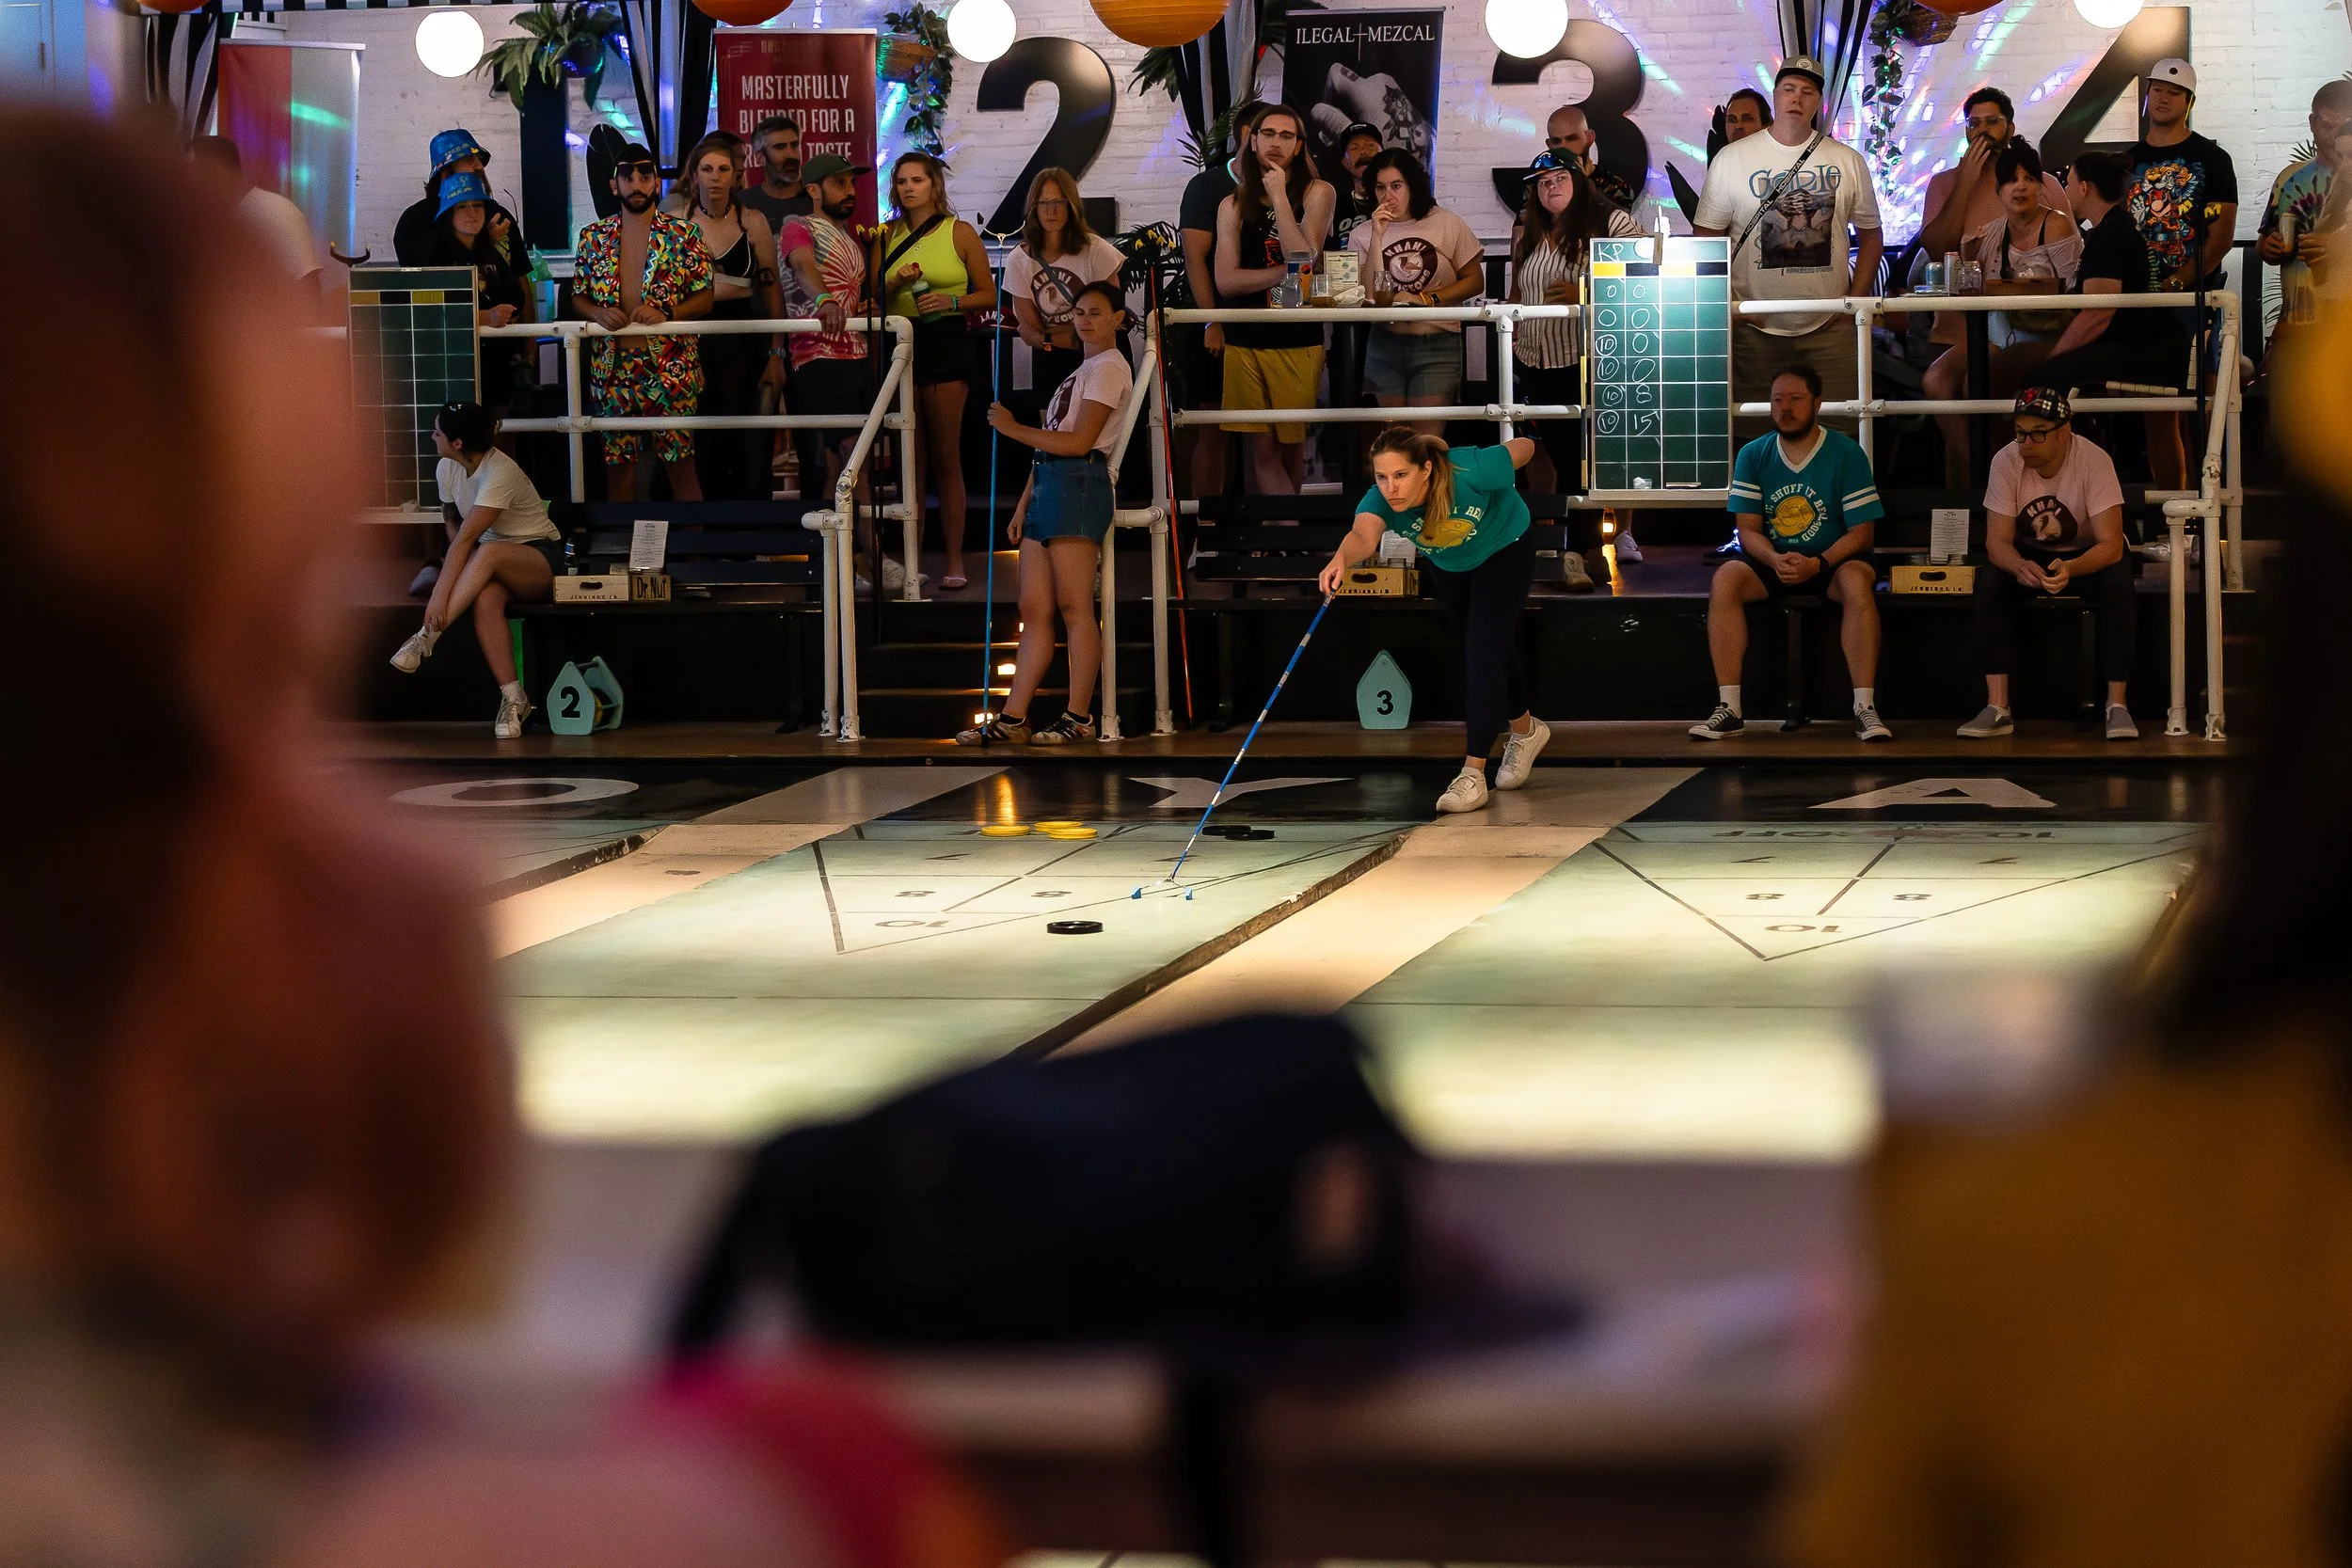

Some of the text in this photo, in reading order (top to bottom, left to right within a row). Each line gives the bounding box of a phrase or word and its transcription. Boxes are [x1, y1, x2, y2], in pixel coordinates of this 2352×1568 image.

[1296, 24, 1436, 44] ILEGAL MEZCAL
[741, 74, 850, 100] MASTERFULLY
[2040, 7, 2217, 179] 4
[812, 108, 840, 133] FOR
[845, 108, 855, 133] A
[1491, 19, 1648, 214] 3
[977, 37, 1117, 240] 2
[1632, 284, 1646, 299] 0
[1597, 309, 1650, 329] 0 0
[1598, 332, 1648, 354] 10 0
[1599, 357, 1656, 383] 10 0
[1635, 384, 1652, 404] 8
[1633, 410, 1658, 436] 15
[560, 686, 580, 719] 2
[1376, 689, 1394, 716] 3
[1807, 778, 2058, 809] A
